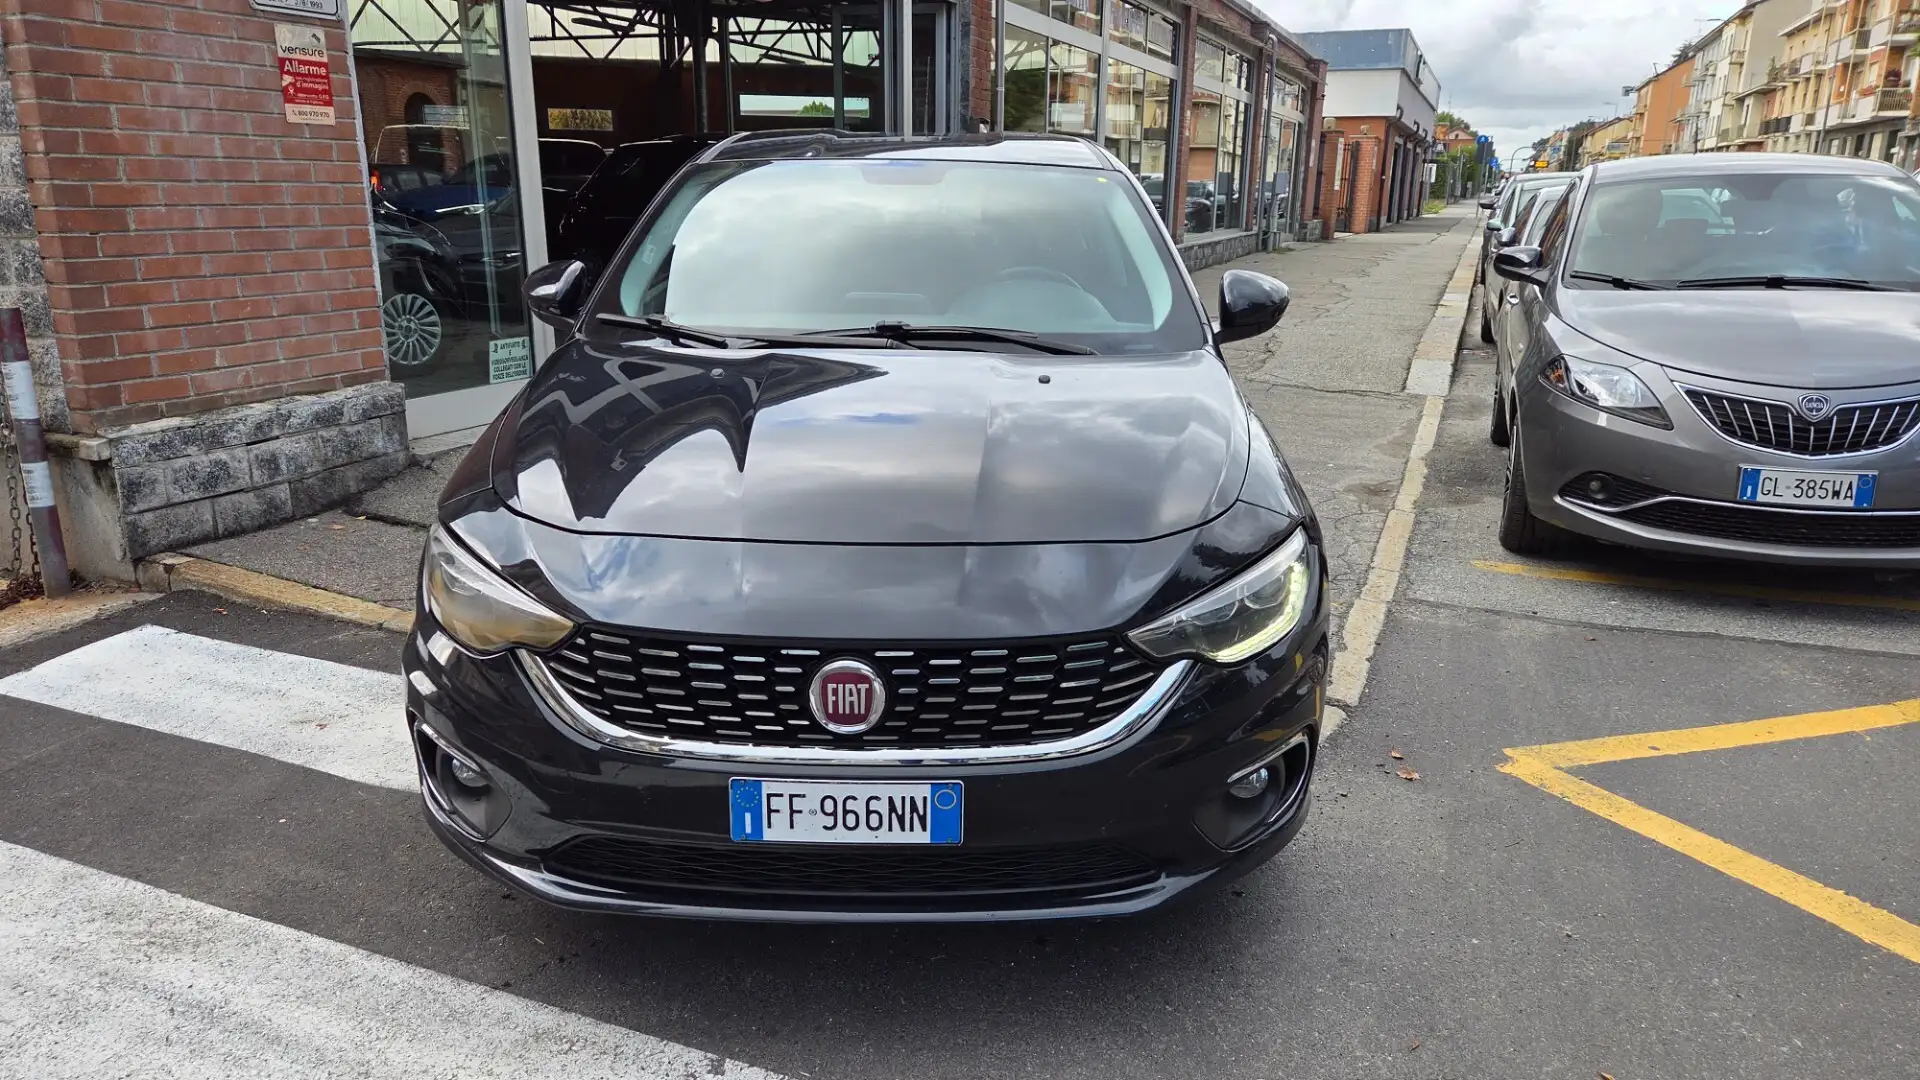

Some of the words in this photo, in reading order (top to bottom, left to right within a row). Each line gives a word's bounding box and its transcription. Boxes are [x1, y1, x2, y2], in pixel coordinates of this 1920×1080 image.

[280, 45, 324, 58] verisure
[284, 60, 327, 75] Allarme
[296, 81, 329, 91] d'immagini
[1760, 476, 1783, 497] GL
[1793, 478, 1854, 501] 385WA
[827, 683, 869, 715] FIAT
[766, 792, 807, 829] FF
[820, 794, 928, 833] 966NN
